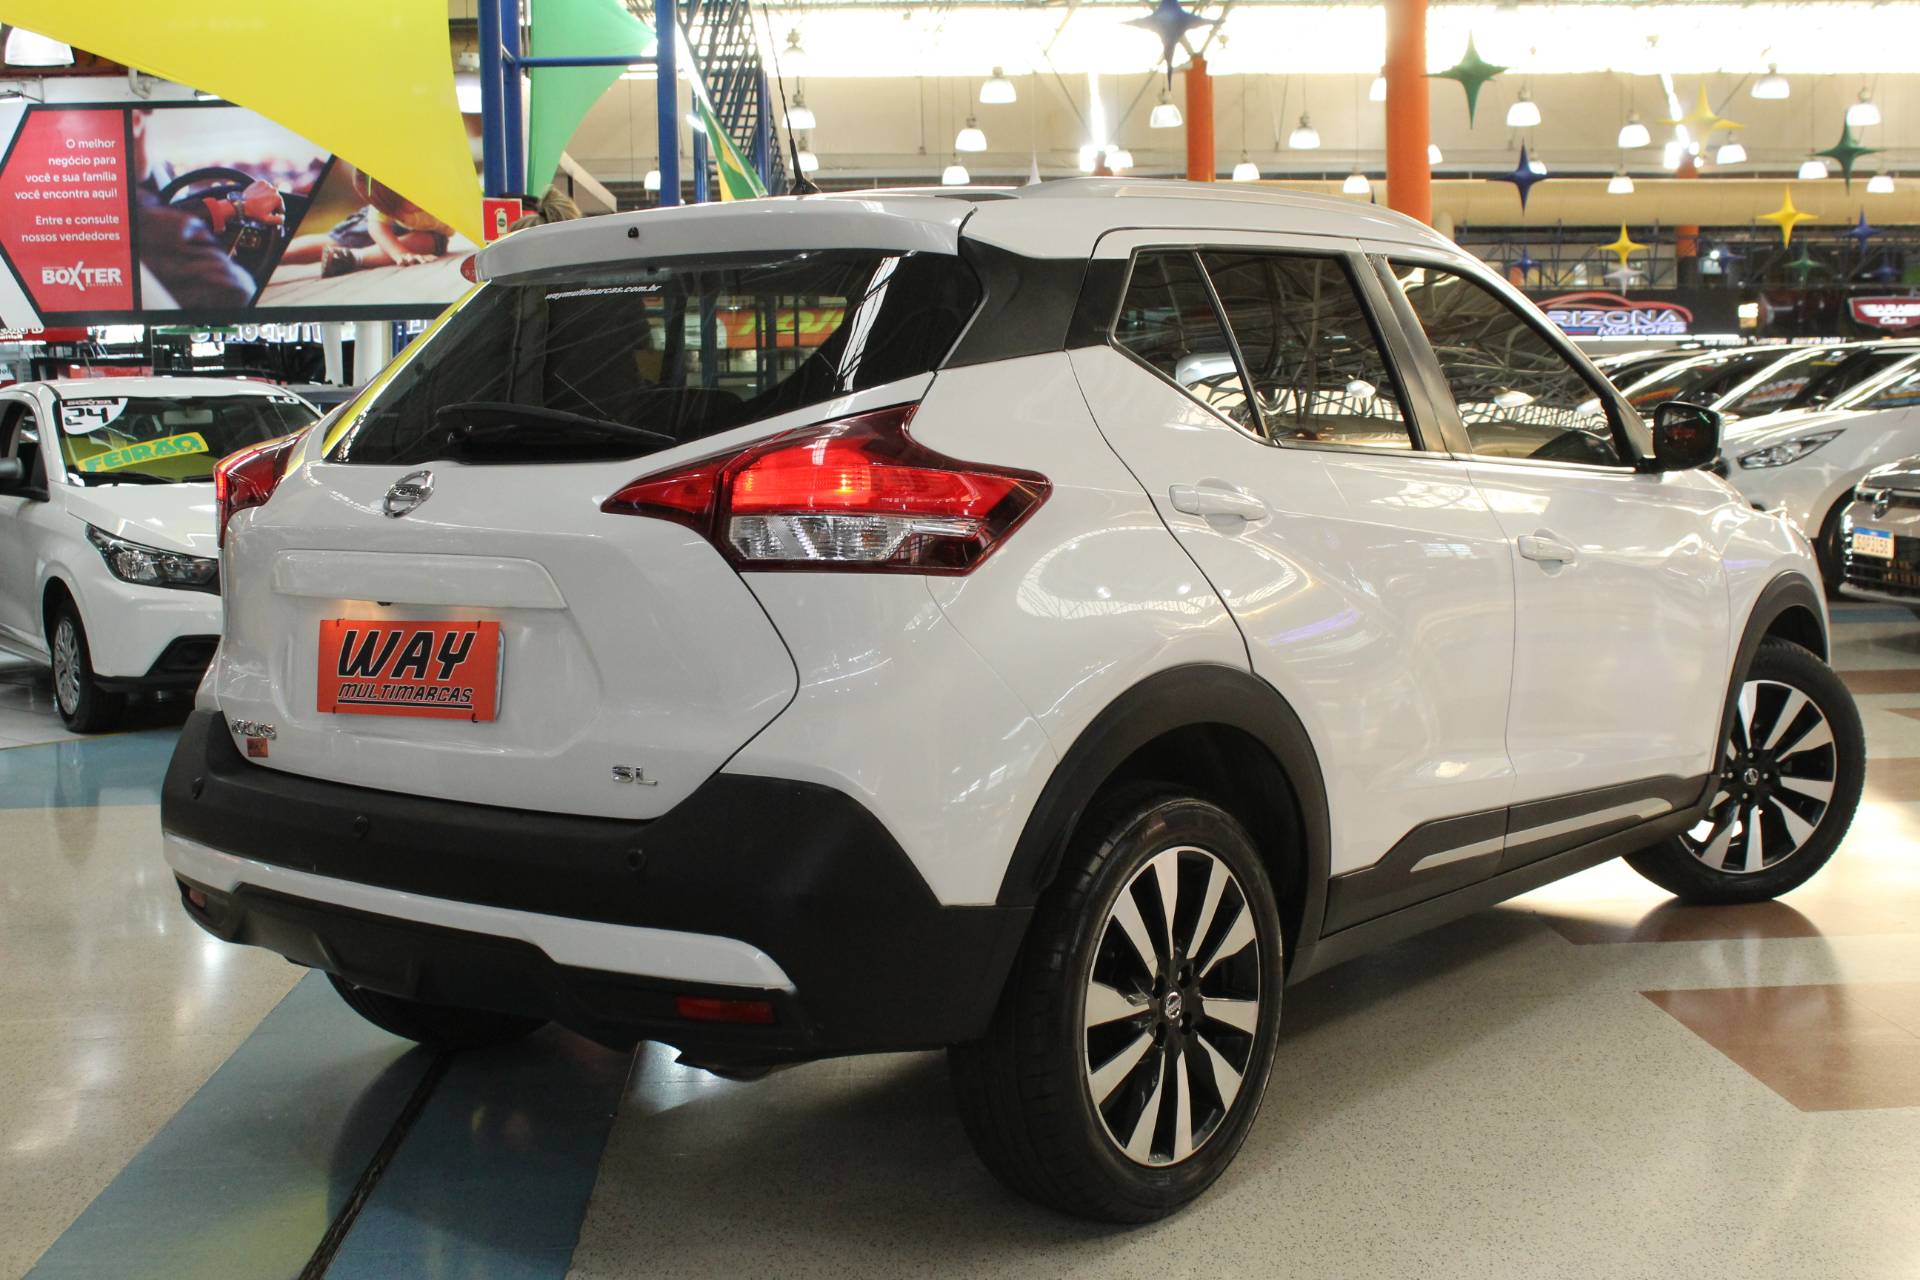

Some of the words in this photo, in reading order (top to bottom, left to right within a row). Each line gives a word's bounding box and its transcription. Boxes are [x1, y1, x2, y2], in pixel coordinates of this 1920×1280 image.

[65, 138, 76, 149] O
[78, 138, 116, 149] melhor
[48, 155, 91, 168] negócio
[93, 157, 117, 167] para
[25, 173, 51, 183] você
[53, 174, 60, 182] e
[62, 174, 80, 182] sua
[82, 171, 117, 181] família
[15, 189, 41, 200] você
[43, 189, 90, 199] encontra
[92, 187, 118, 200] aqui!
[35, 215, 63, 225] Entre
[65, 216, 72, 224] e
[74, 214, 120, 224] consulte
[21, 233, 57, 243] nossos
[59, 231, 120, 242] vendedores
[42, 260, 123, 291] BOXTER
[1546, 309, 1687, 327] RIZONA
[1597, 322, 1687, 336] MOTORS
[84, 434, 202, 472] FEIRÃO
[336, 629, 477, 681] WAY
[338, 682, 473, 704] MULTIMARCAS
[611, 765, 658, 787] SL
